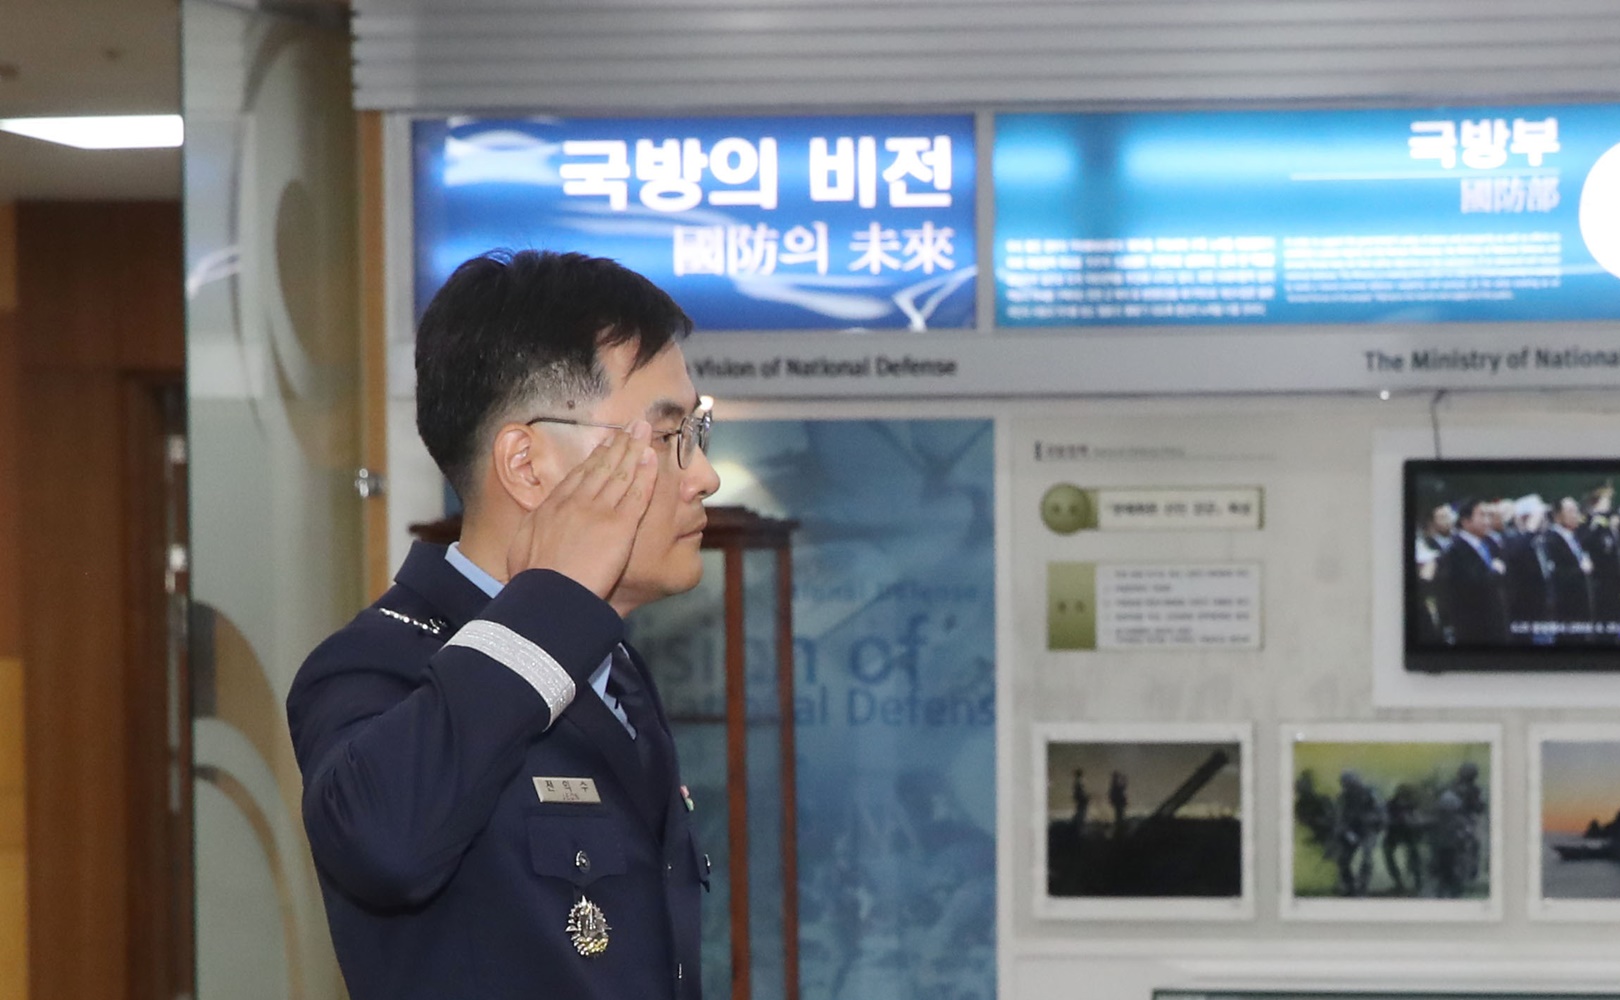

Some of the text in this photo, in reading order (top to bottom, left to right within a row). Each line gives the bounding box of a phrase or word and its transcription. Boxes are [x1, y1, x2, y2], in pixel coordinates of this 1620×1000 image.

[1408, 117, 1561, 169] 국방부
[559, 135, 952, 212] 국방의 비전
[848, 221, 955, 275] 未來
[692, 357, 757, 377] Vision
[760, 356, 782, 378] of
[786, 355, 871, 377] National
[874, 354, 957, 377] Defense
[1366, 350, 1404, 371] The
[1411, 349, 1500, 375] Ministry
[1506, 346, 1529, 371] of
